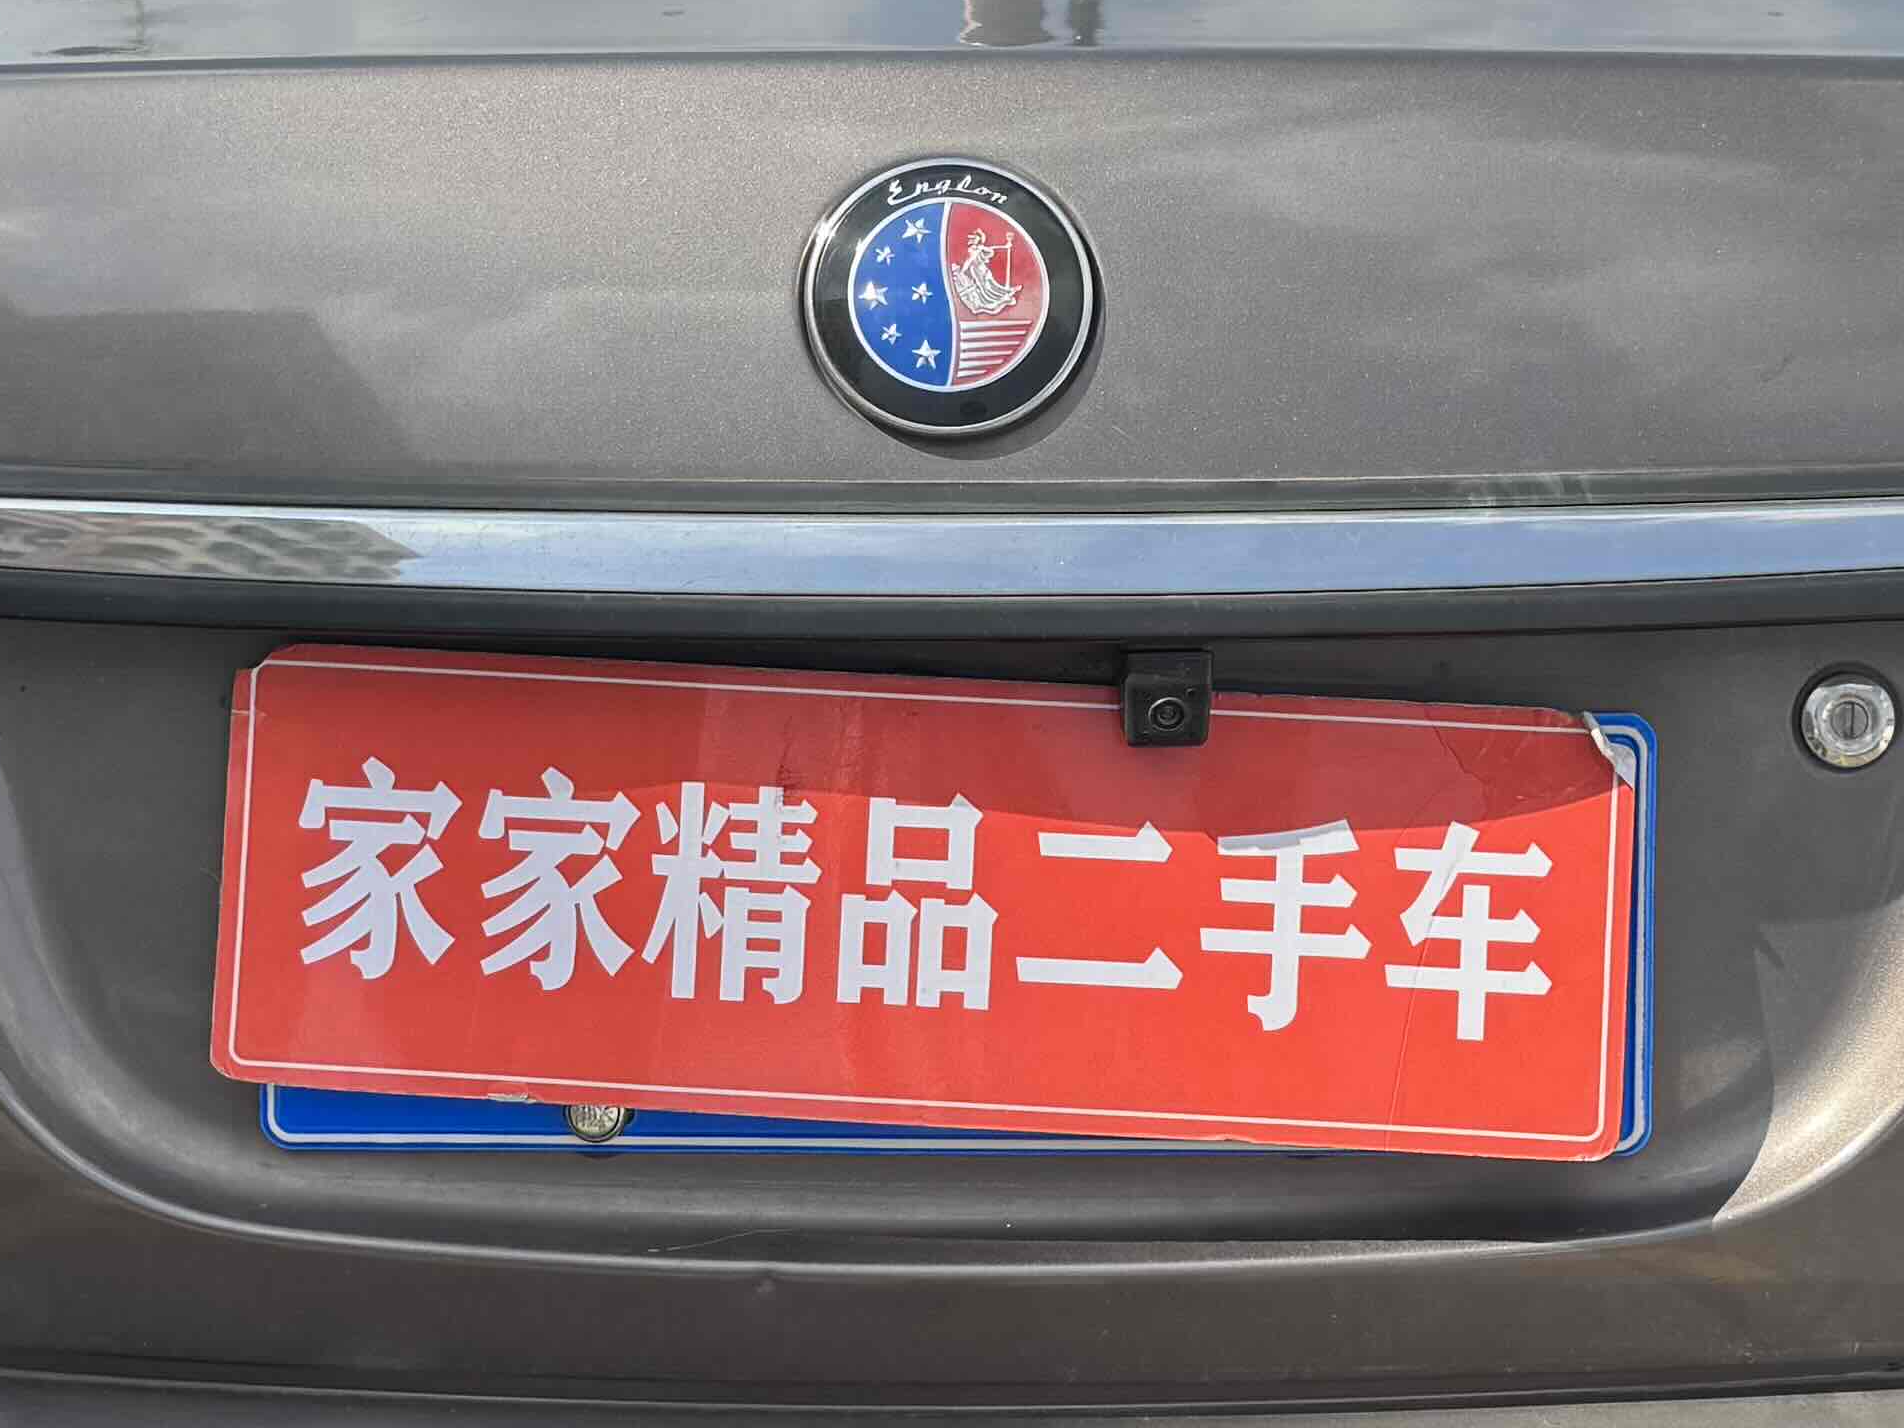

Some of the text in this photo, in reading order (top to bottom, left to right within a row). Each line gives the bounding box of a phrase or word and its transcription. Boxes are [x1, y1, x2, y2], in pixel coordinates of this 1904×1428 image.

[886, 174, 1009, 206] Englon
[295, 755, 1556, 1043] 家家精品二手车
